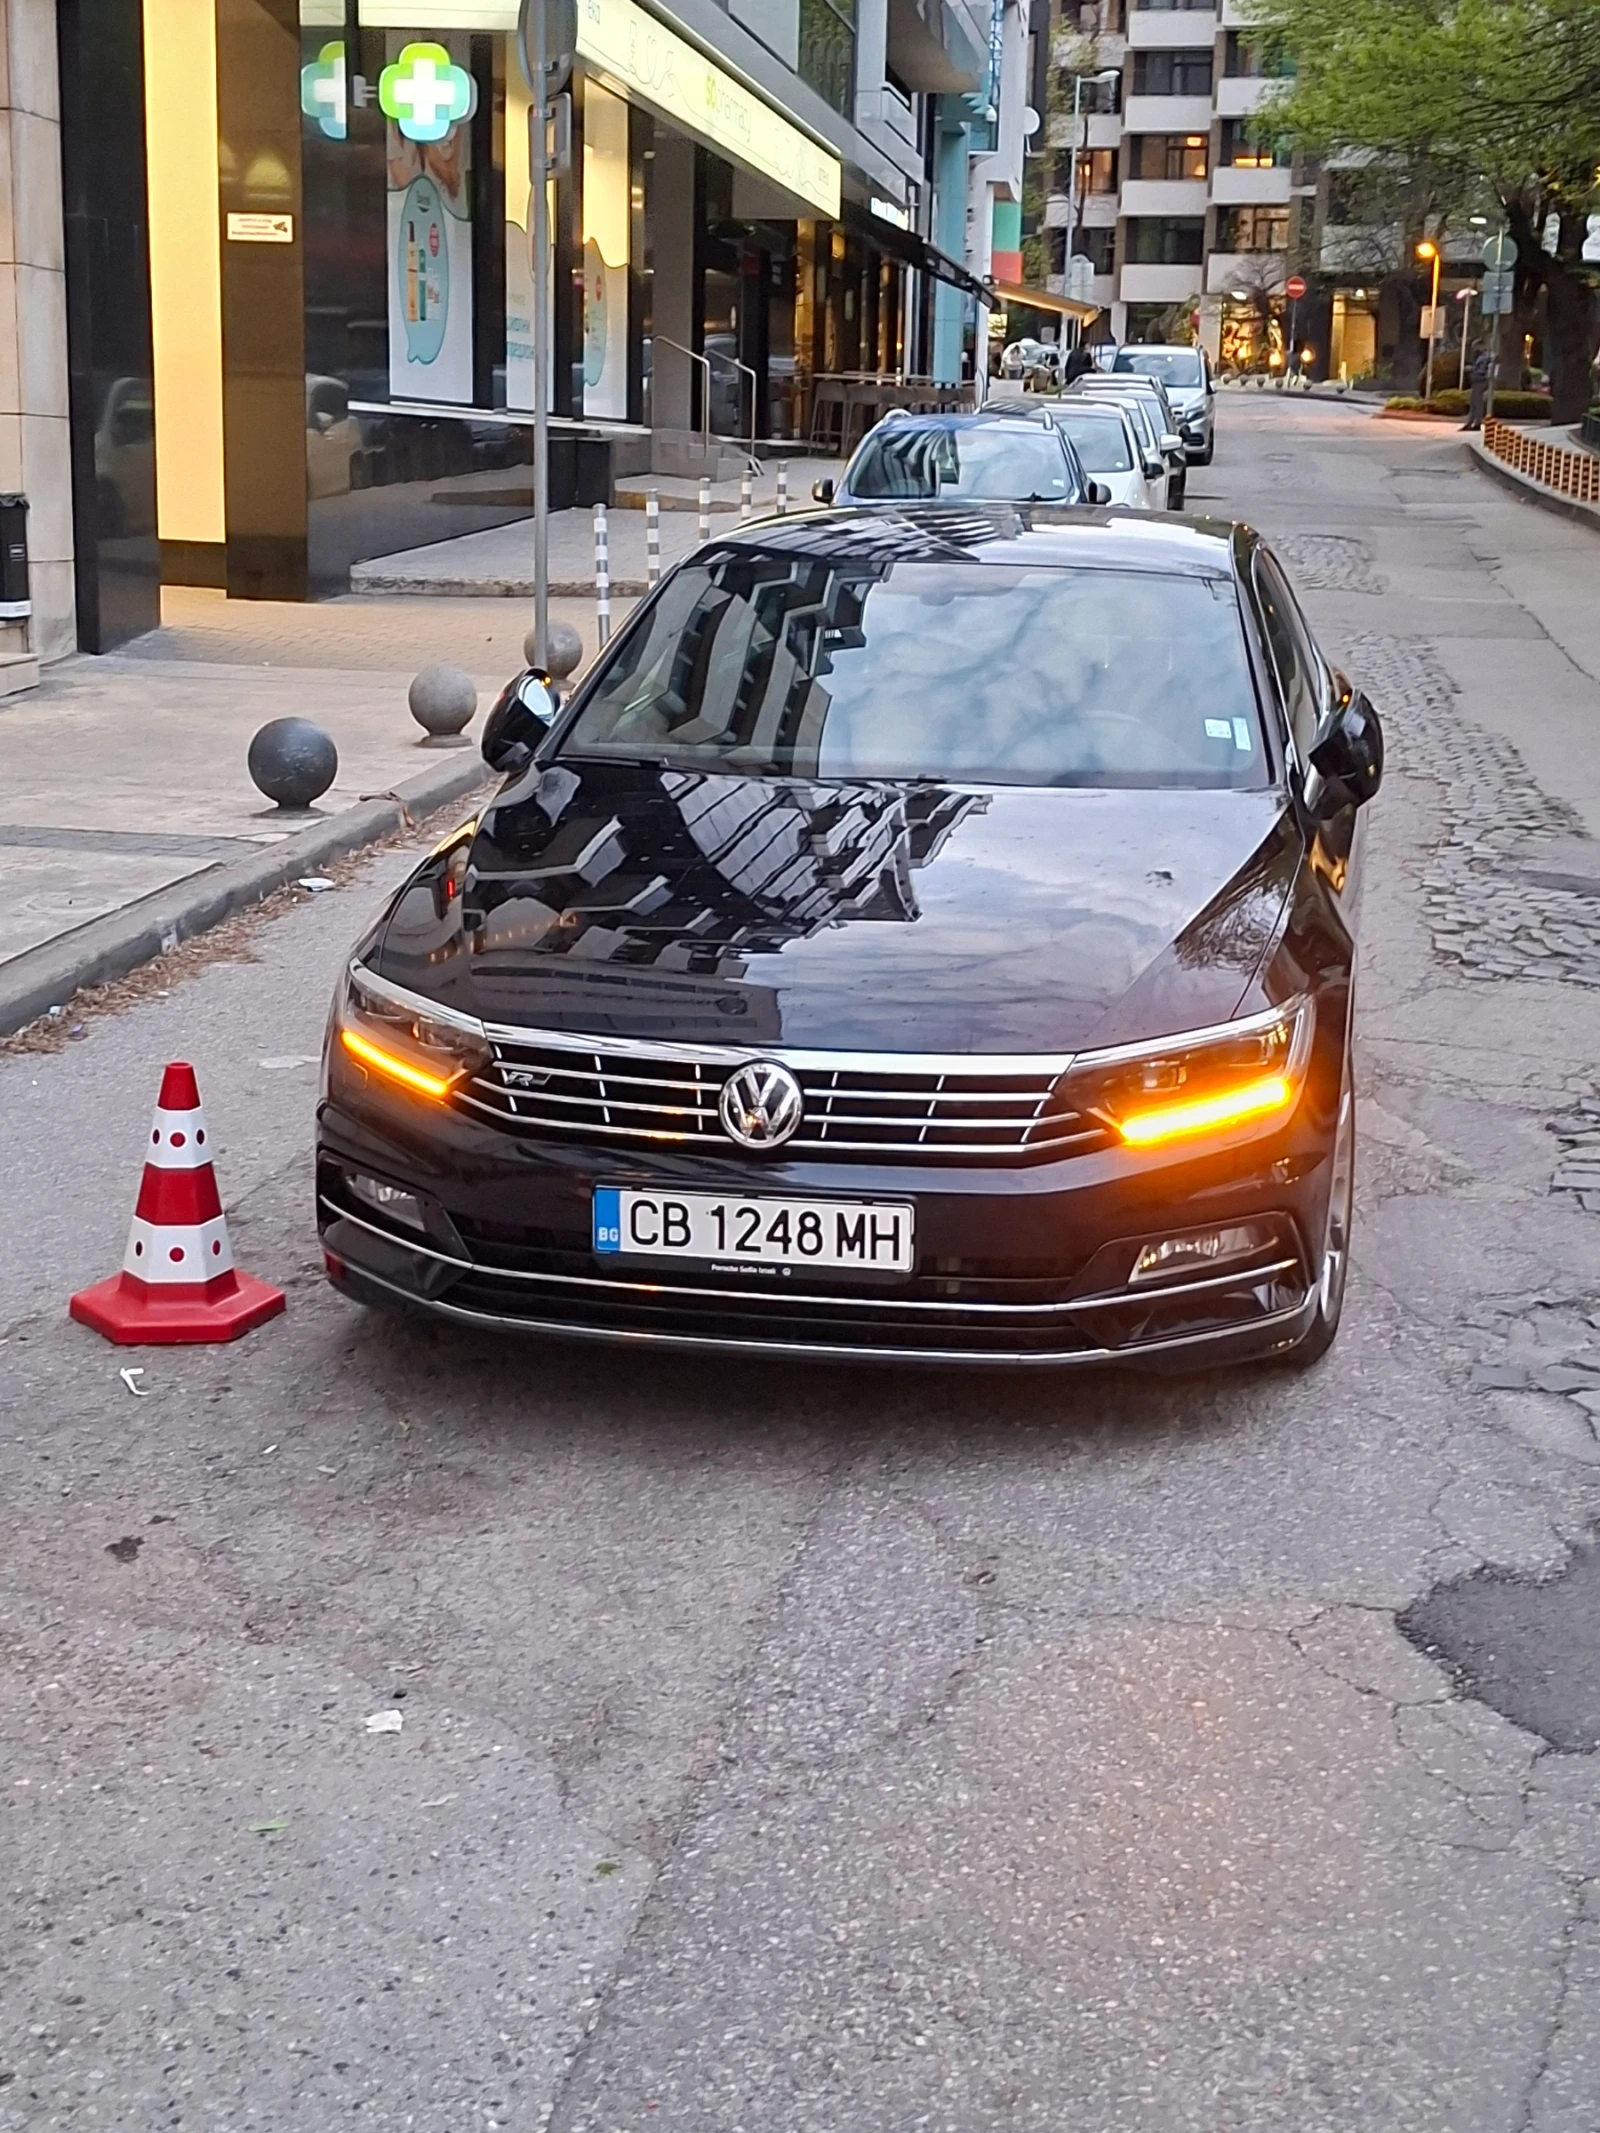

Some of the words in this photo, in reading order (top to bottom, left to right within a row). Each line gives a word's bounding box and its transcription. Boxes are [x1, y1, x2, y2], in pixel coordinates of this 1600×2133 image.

[598, 1227, 619, 1242] BG
[630, 1199, 692, 1248] CB
[710, 1204, 824, 1257] 1248
[836, 1212, 900, 1261] MH
